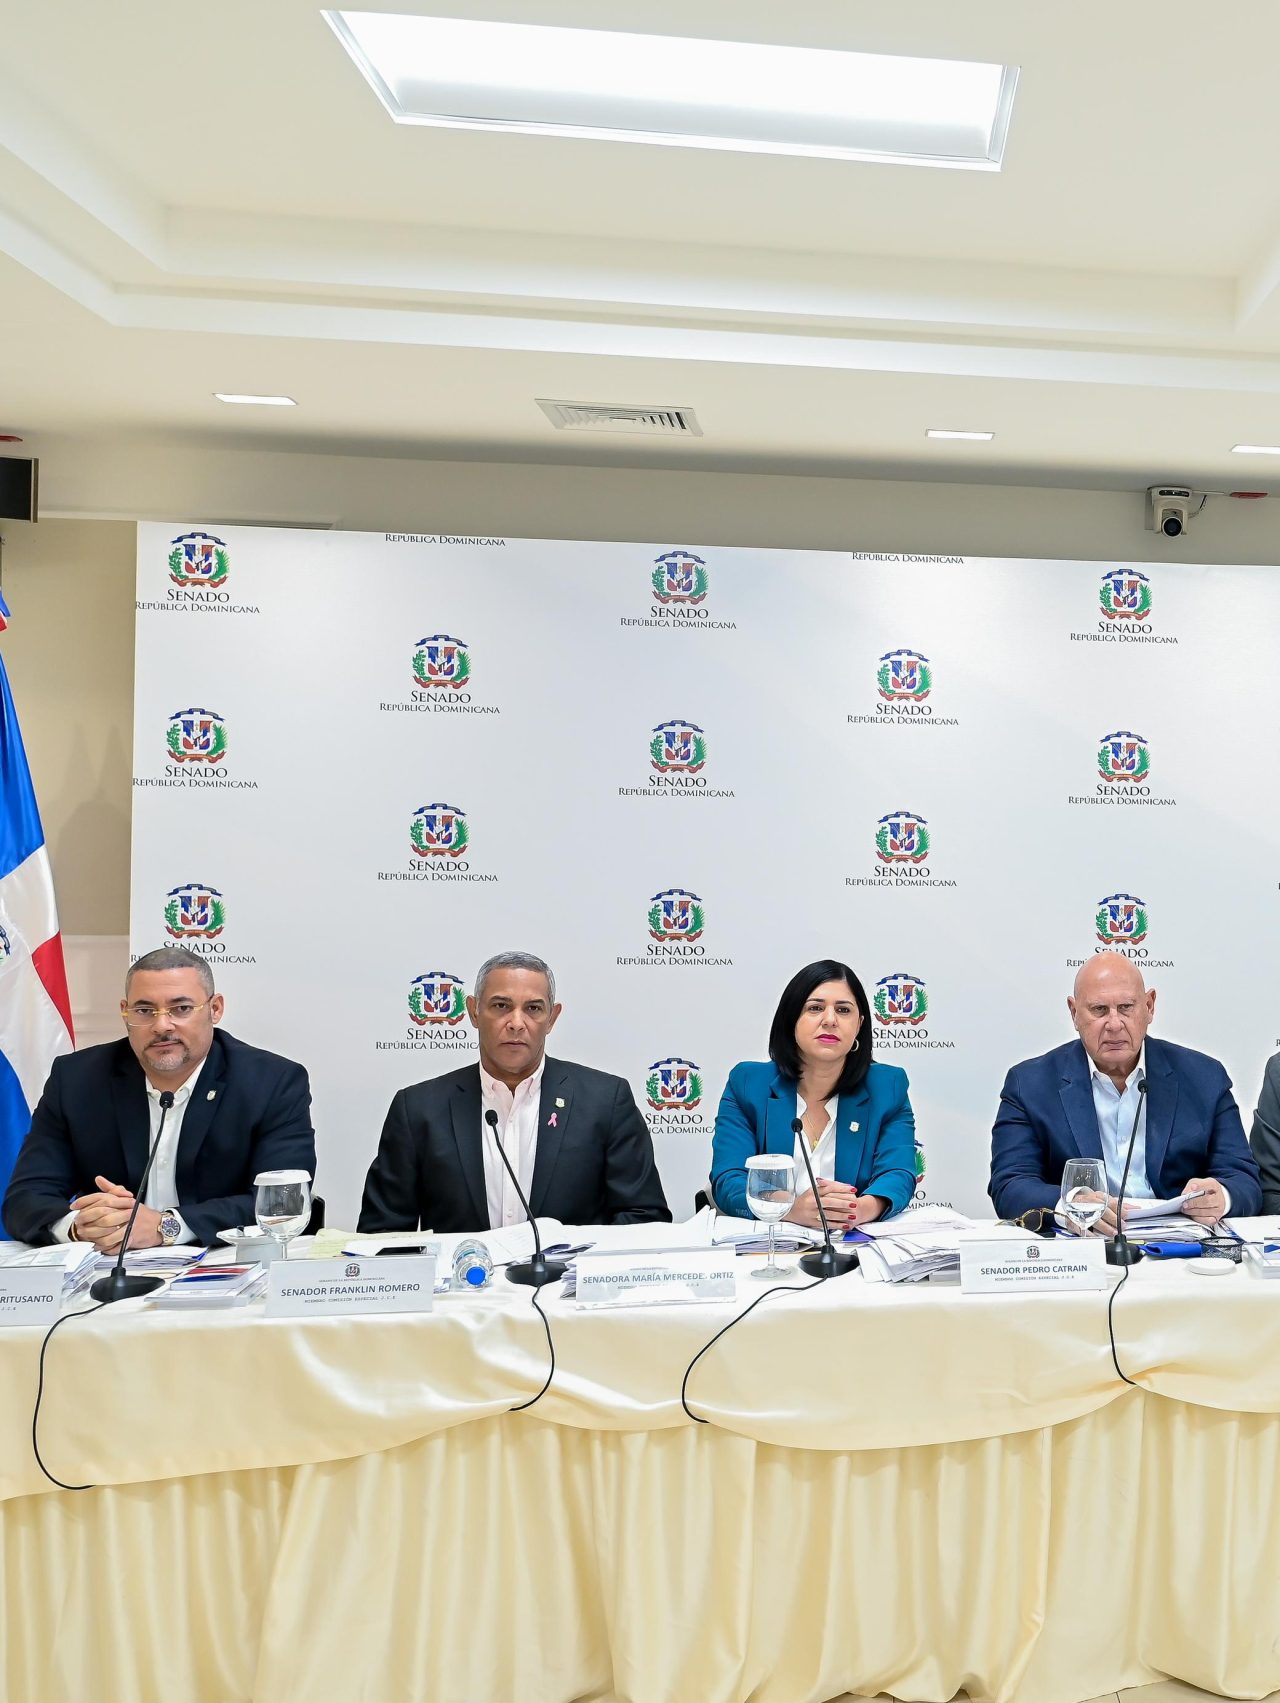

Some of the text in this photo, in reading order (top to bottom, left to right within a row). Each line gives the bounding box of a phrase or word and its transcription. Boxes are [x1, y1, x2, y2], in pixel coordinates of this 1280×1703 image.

[440, 538, 505, 546] DOMINICANA
[902, 553, 963, 564] DOMINICANA
[167, 589, 229, 603] SENADO
[192, 603, 260, 613] DOMINICANA
[651, 606, 708, 619] SENADO
[673, 620, 736, 629] DOMINICANA
[1098, 621, 1152, 634] SENADO
[1119, 635, 1178, 644] DOMINICANA
[411, 690, 471, 703] SENADO
[434, 705, 500, 713] DOMINICANA
[876, 703, 932, 715] SENADO
[898, 717, 958, 725] DOMINICANA
[165, 765, 227, 778] SENADO
[189, 779, 258, 788] DOMINICANA
[649, 775, 706, 787] SENADO
[671, 789, 735, 797] DOMINICANA
[1097, 784, 1150, 796] SENADO
[1117, 797, 1176, 805] DOMINICANA
[409, 859, 469, 871] SENADO
[874, 865, 930, 877] SENADO
[432, 873, 498, 881] DOMINICANA
[647, 944, 705, 956] SENADO
[407, 1028, 467, 1040] SENADO
[872, 1028, 928, 1039] SENADO
[894, 1040, 955, 1049] DOMINICANA
[645, 1113, 702, 1124] SENADO
[981, 1265, 1088, 1275] SENADOR PEDRO CATRAIN
[583, 1271, 734, 1284] SENADORA MARÍA MERCEDE ORTIZ
[281, 1283, 420, 1297] SENADOR FRANKLIN ROMERO
